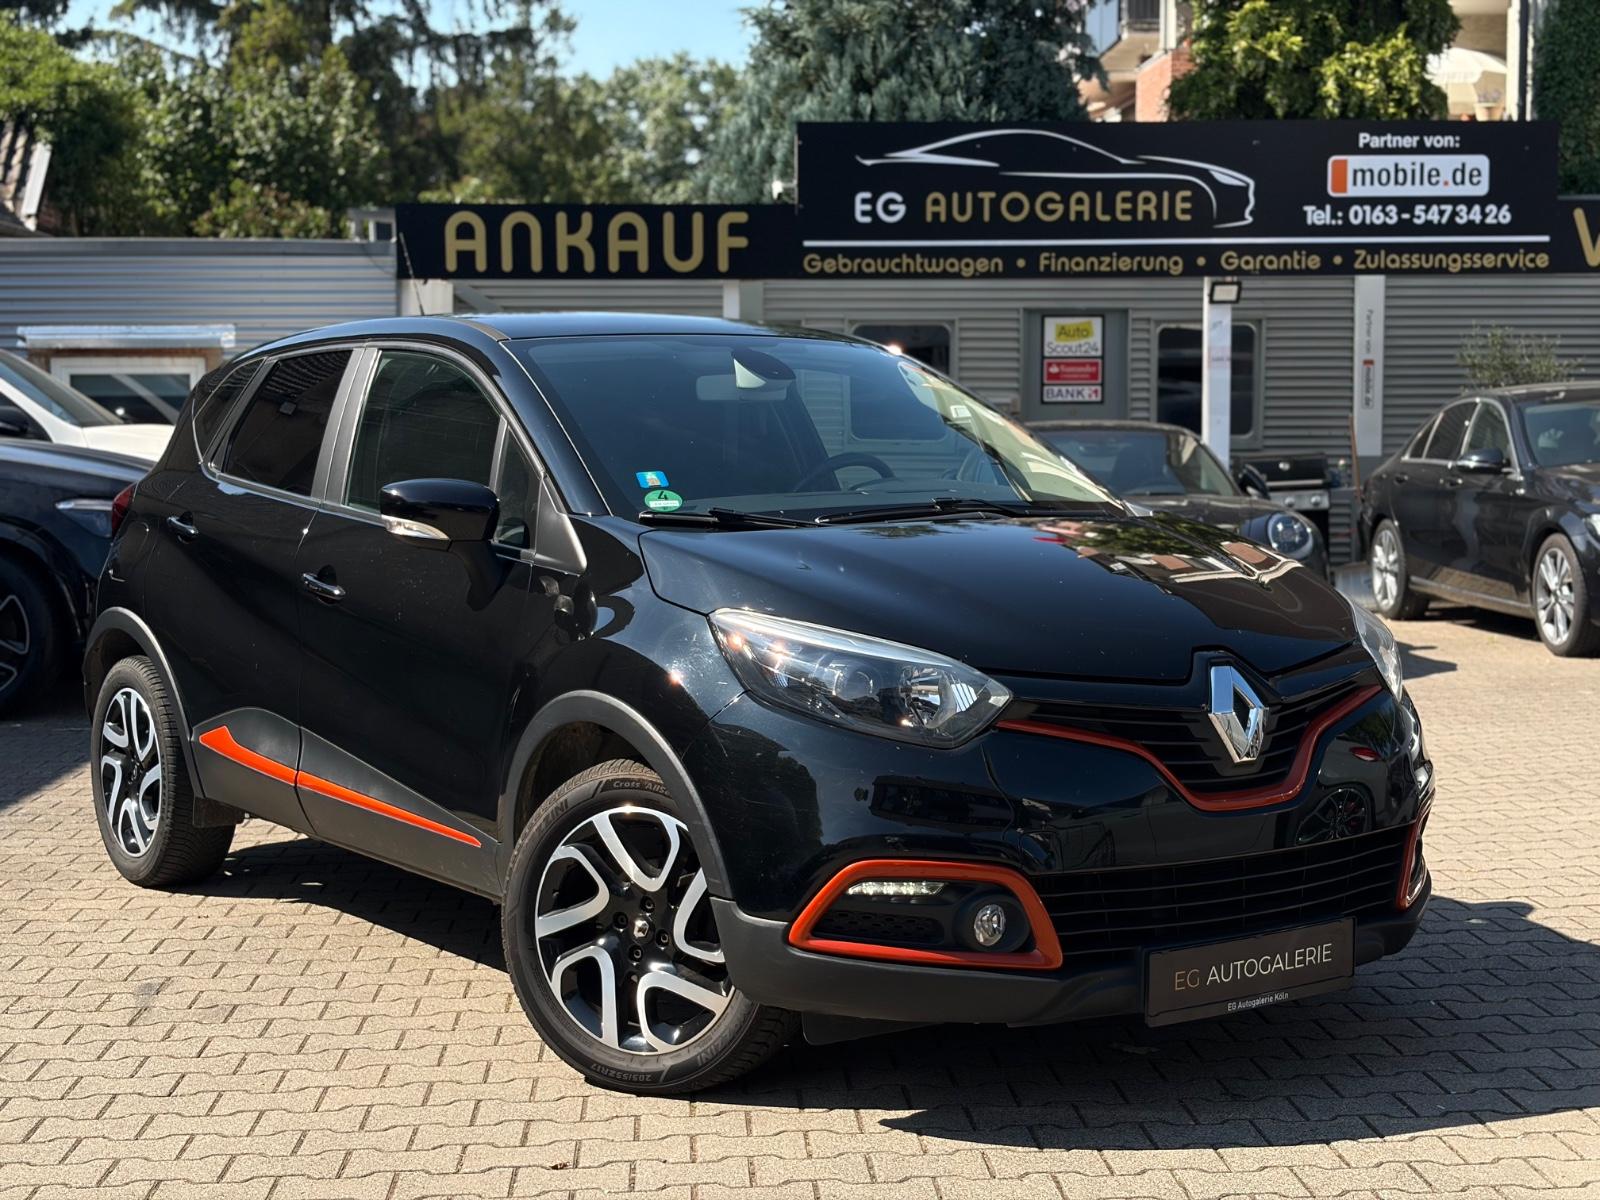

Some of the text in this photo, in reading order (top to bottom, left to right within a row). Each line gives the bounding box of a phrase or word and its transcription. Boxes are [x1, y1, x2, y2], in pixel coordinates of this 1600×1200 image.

[1358, 133, 1460, 148] Partner von:
[1352, 162, 1482, 187] mobile.de
[854, 190, 1193, 223] EG AUTOGALERIE
[1303, 204, 1343, 225] Tel.:
[444, 210, 749, 273] ANKAUF
[803, 249, 1550, 278] Gebrauchtwagen Finanzierung Garantie Zulassungsservice
[1059, 325, 1089, 338] Auto
[1047, 342, 1099, 354] Scout24
[658, 490, 668, 500] 4
[613, 780, 641, 789] Cross
[1174, 943, 1333, 991] EG AUTOGALERIE
[1227, 992, 1289, 1012] EG Autogalerie Köln
